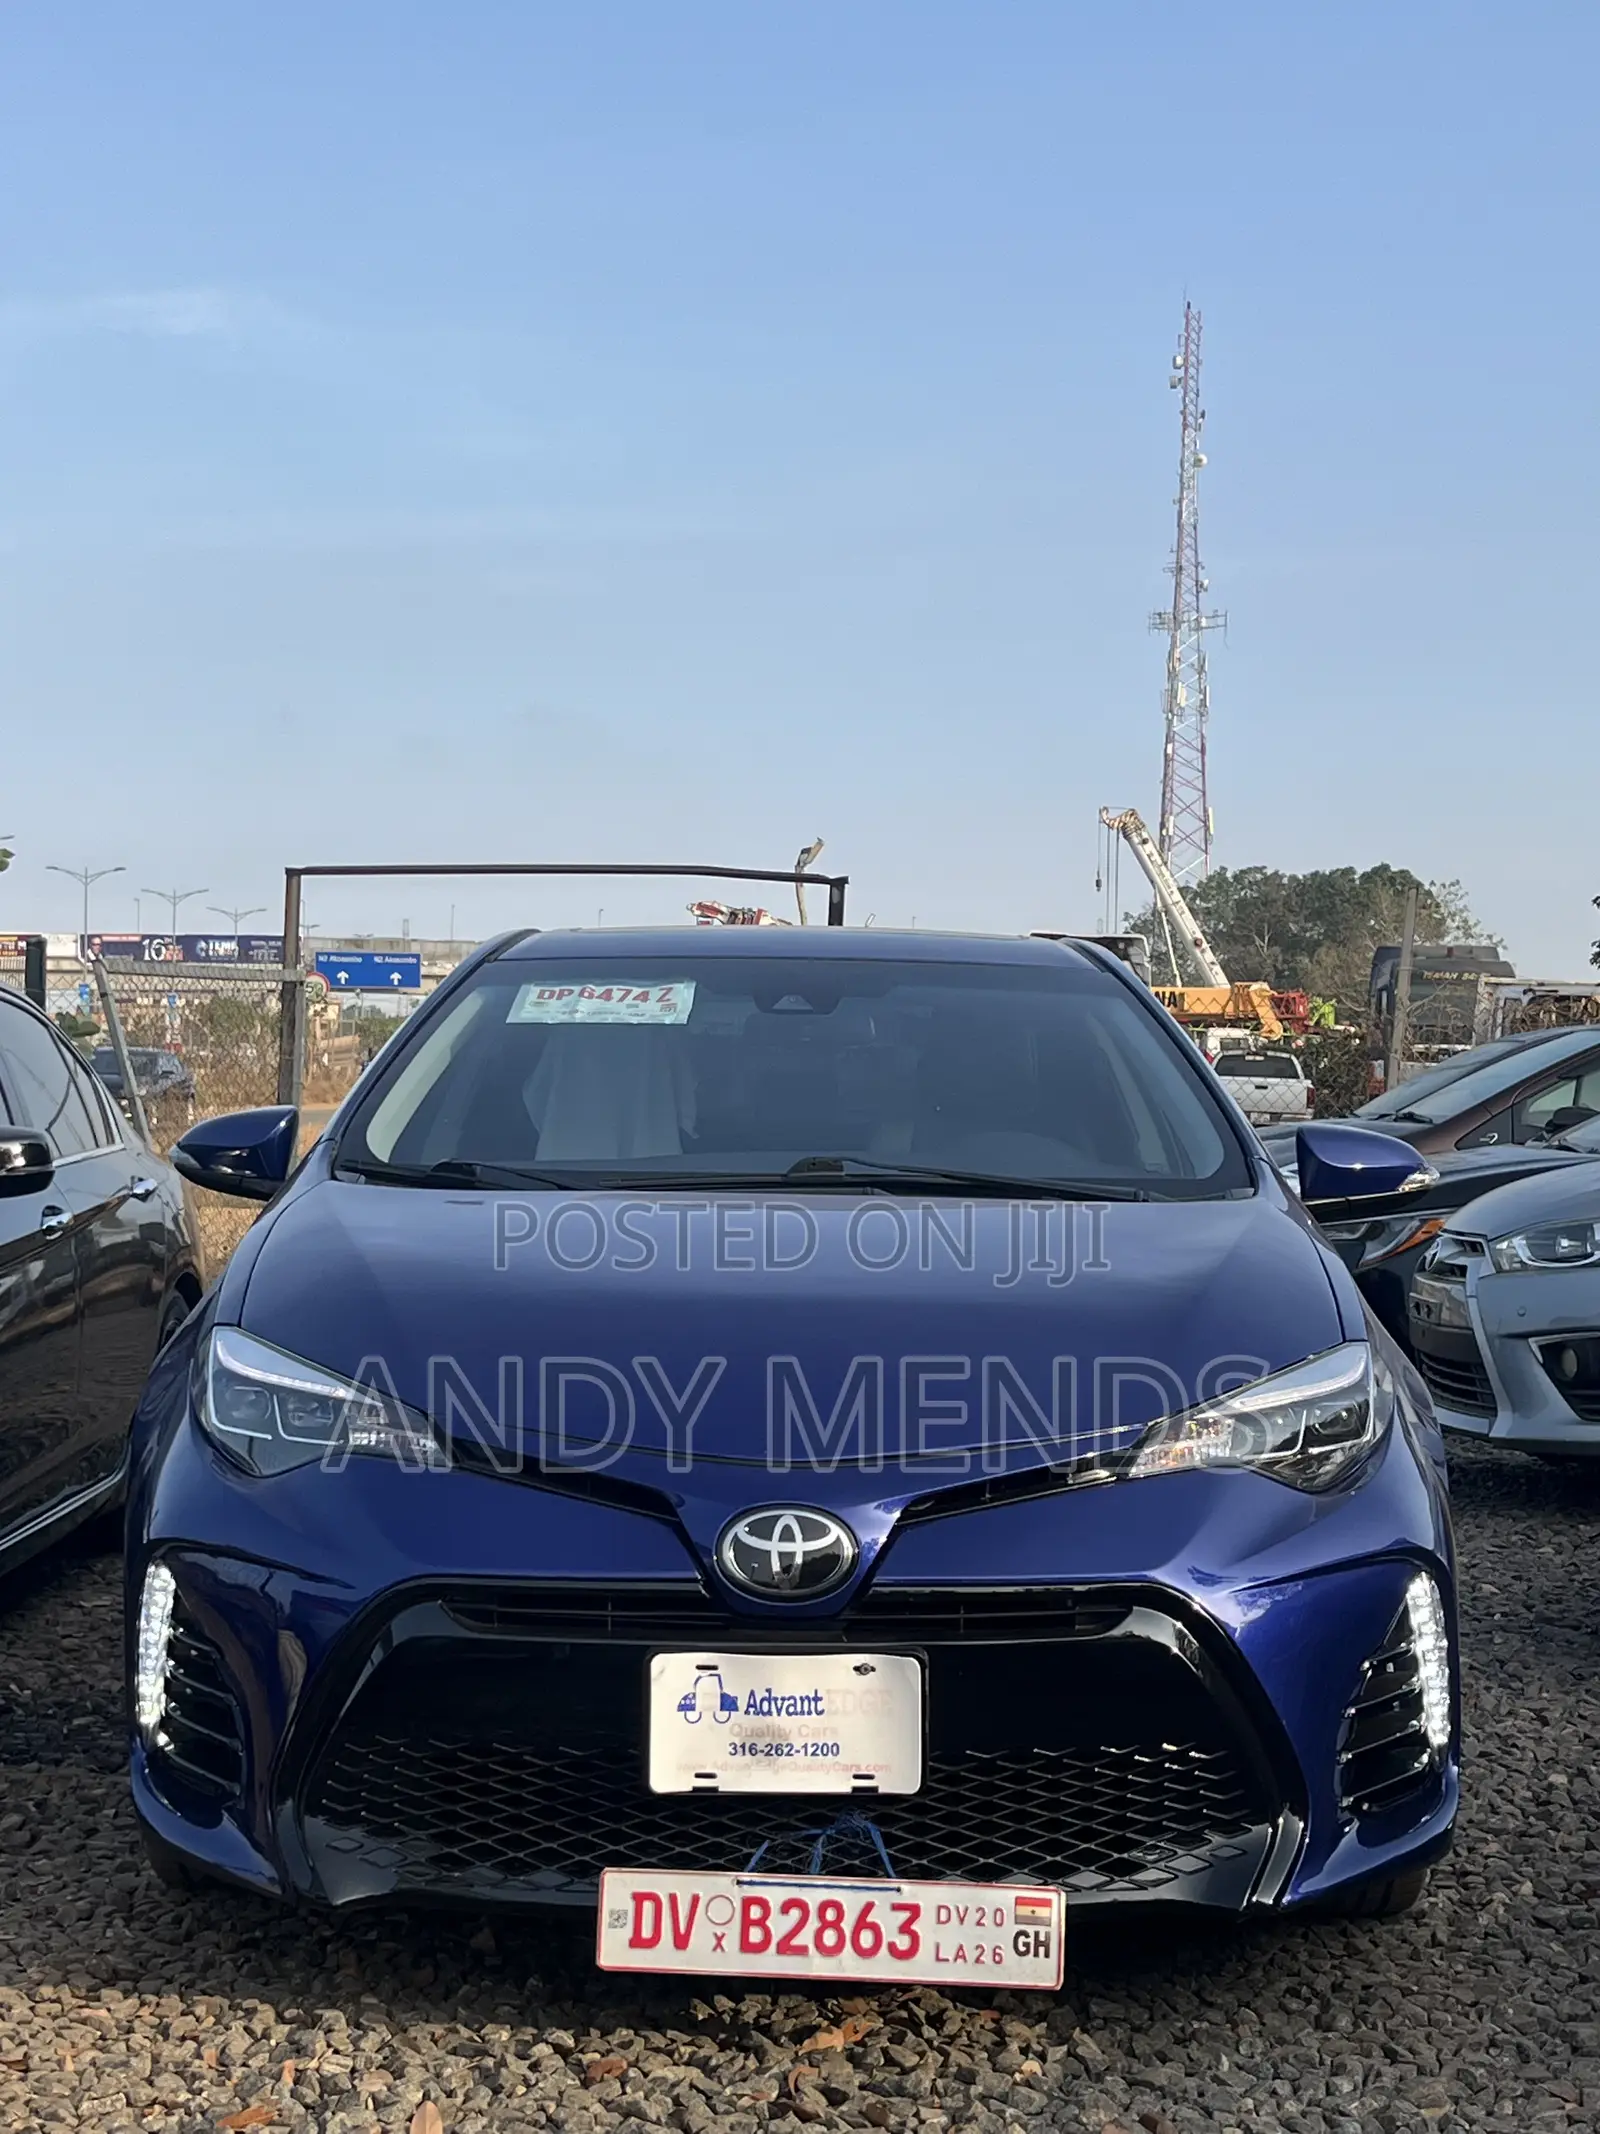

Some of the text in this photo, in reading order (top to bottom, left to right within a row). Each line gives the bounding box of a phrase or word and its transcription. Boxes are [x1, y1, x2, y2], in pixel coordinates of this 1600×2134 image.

[536, 986, 674, 1003] DP 6474 Z
[729, 1722, 839, 1741] Quality Cars
[728, 1742, 840, 1757] 316-262-1200
[629, 1891, 922, 1960] DV B2863
[1013, 1930, 1050, 1958] GH
